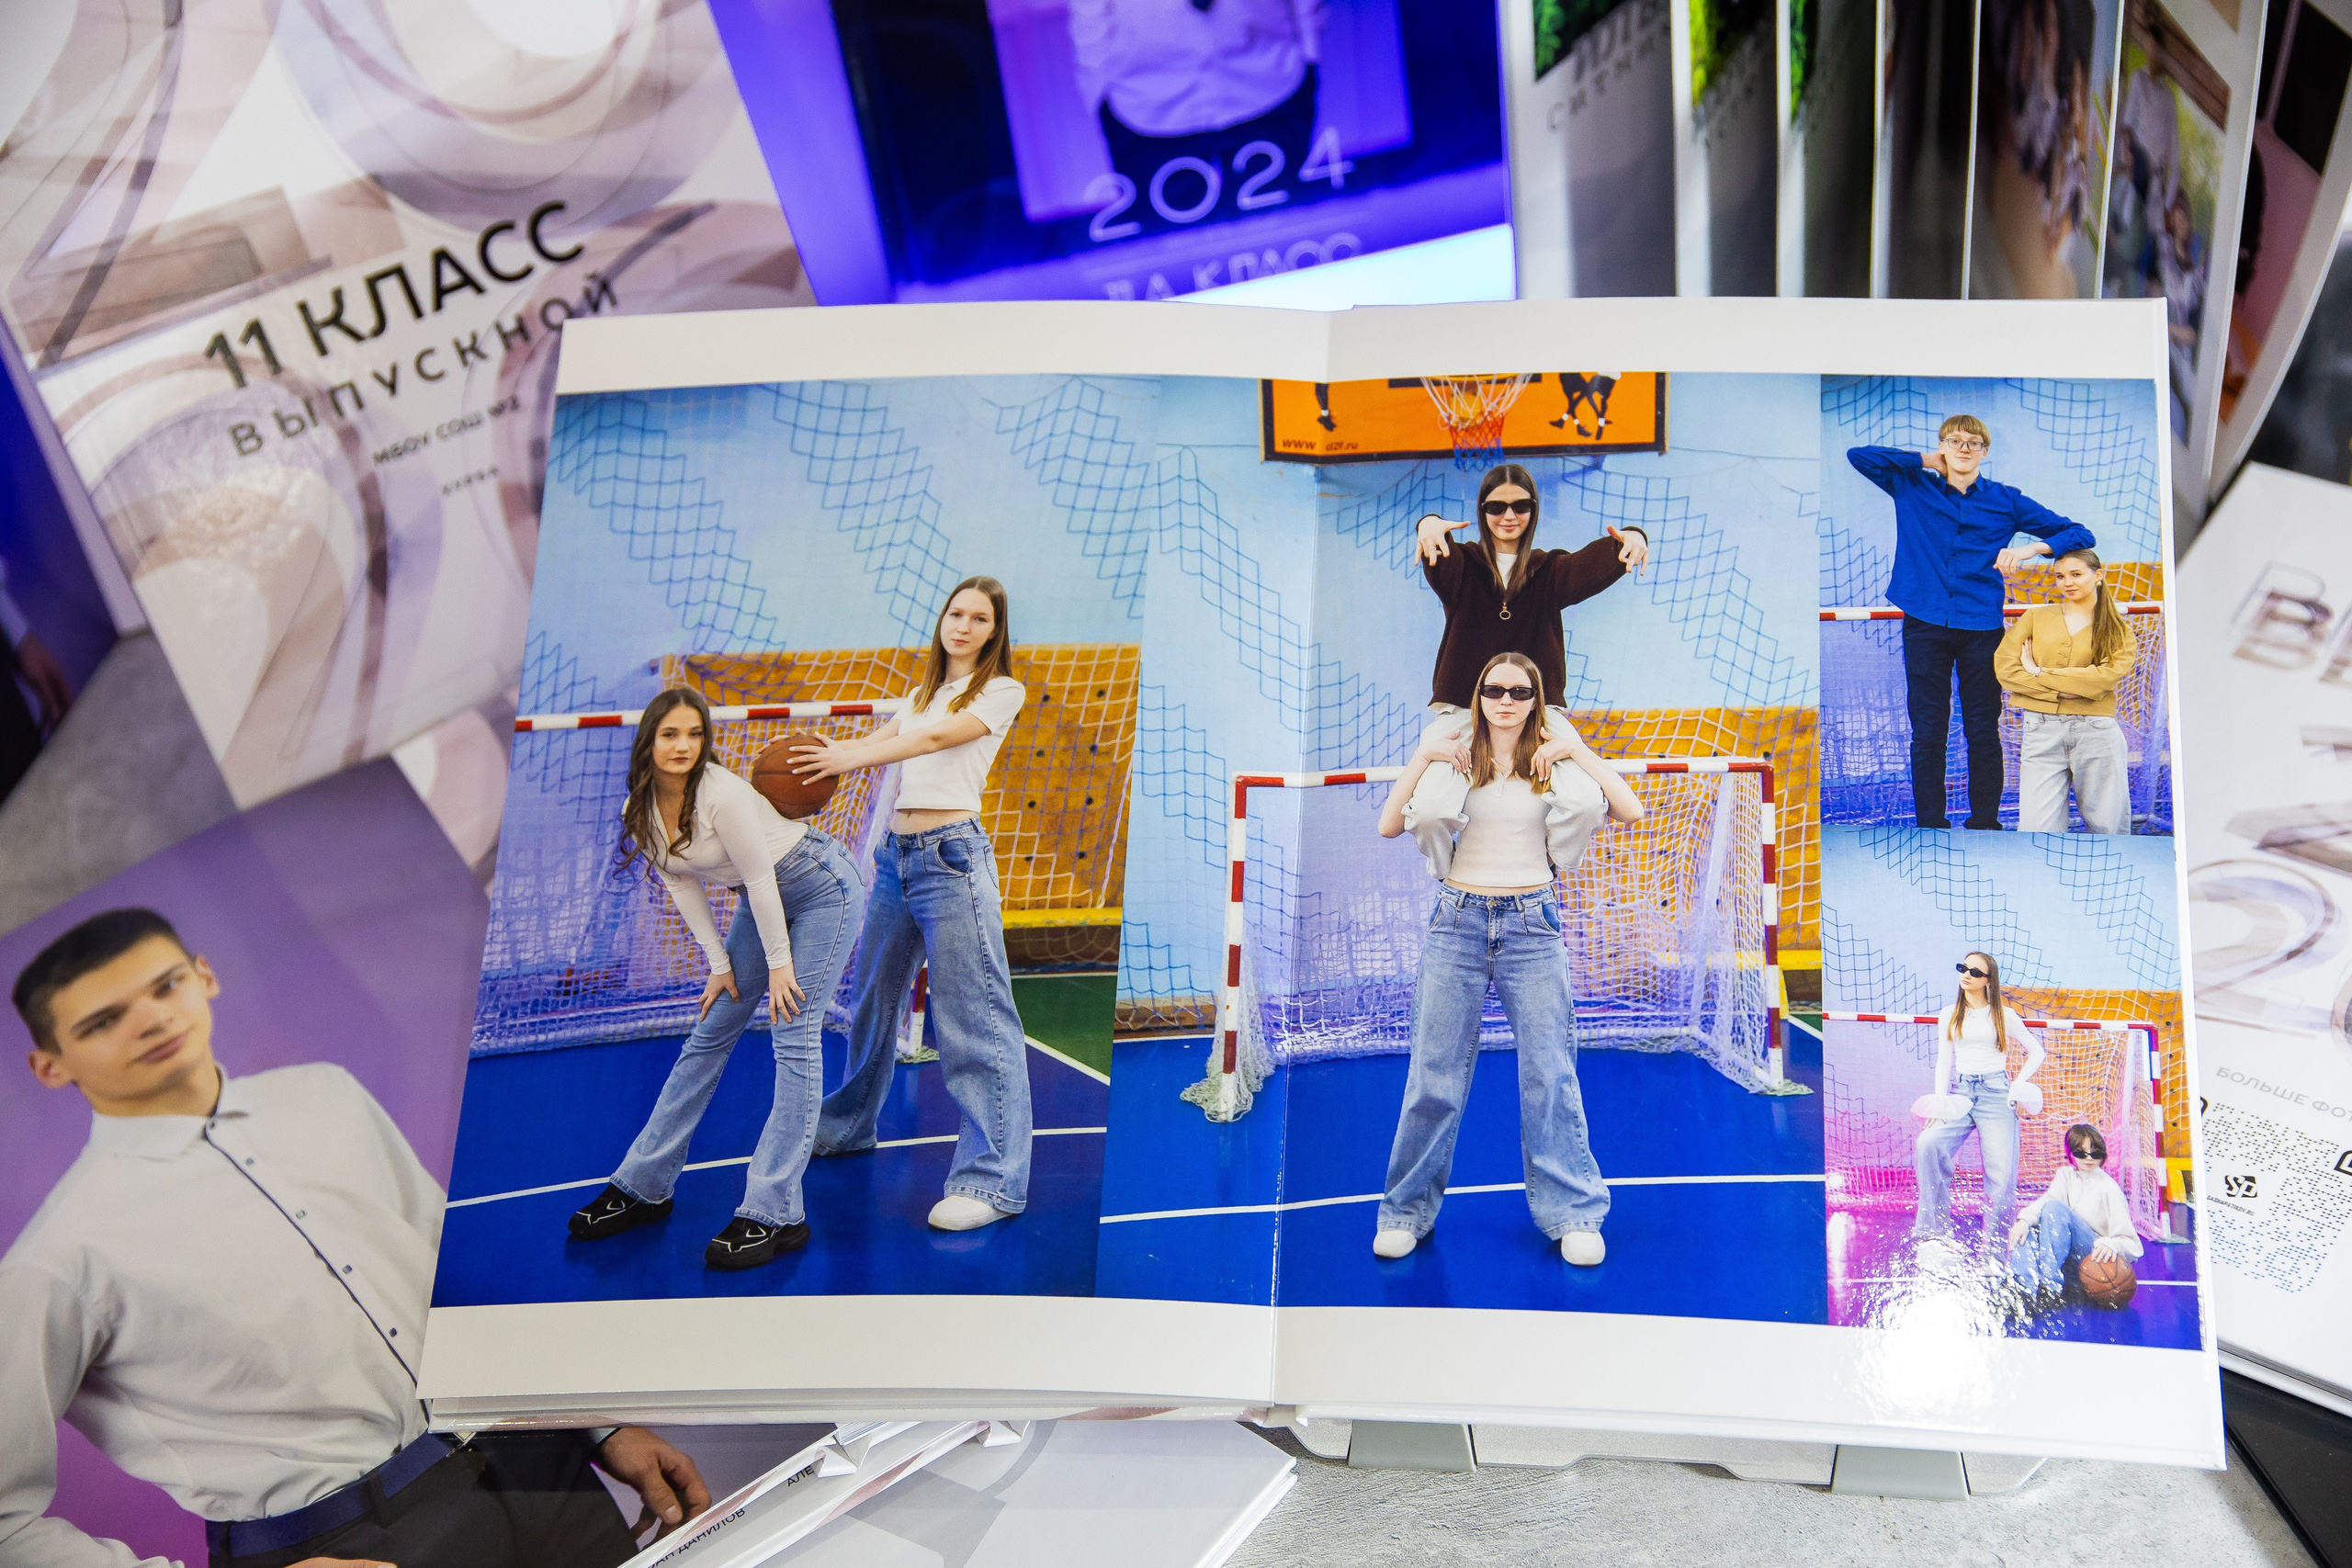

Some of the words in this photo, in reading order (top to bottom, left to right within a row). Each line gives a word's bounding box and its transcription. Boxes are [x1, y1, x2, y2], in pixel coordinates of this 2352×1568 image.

[1084, 127, 1356, 242] 2024
[204, 317, 282, 389] 11
[296, 199, 585, 357] КЛАСС
[227, 270, 619, 457] ВЫПУСКНОЙ
[2216, 1066, 2309, 1106] БОЛЬШЕ
